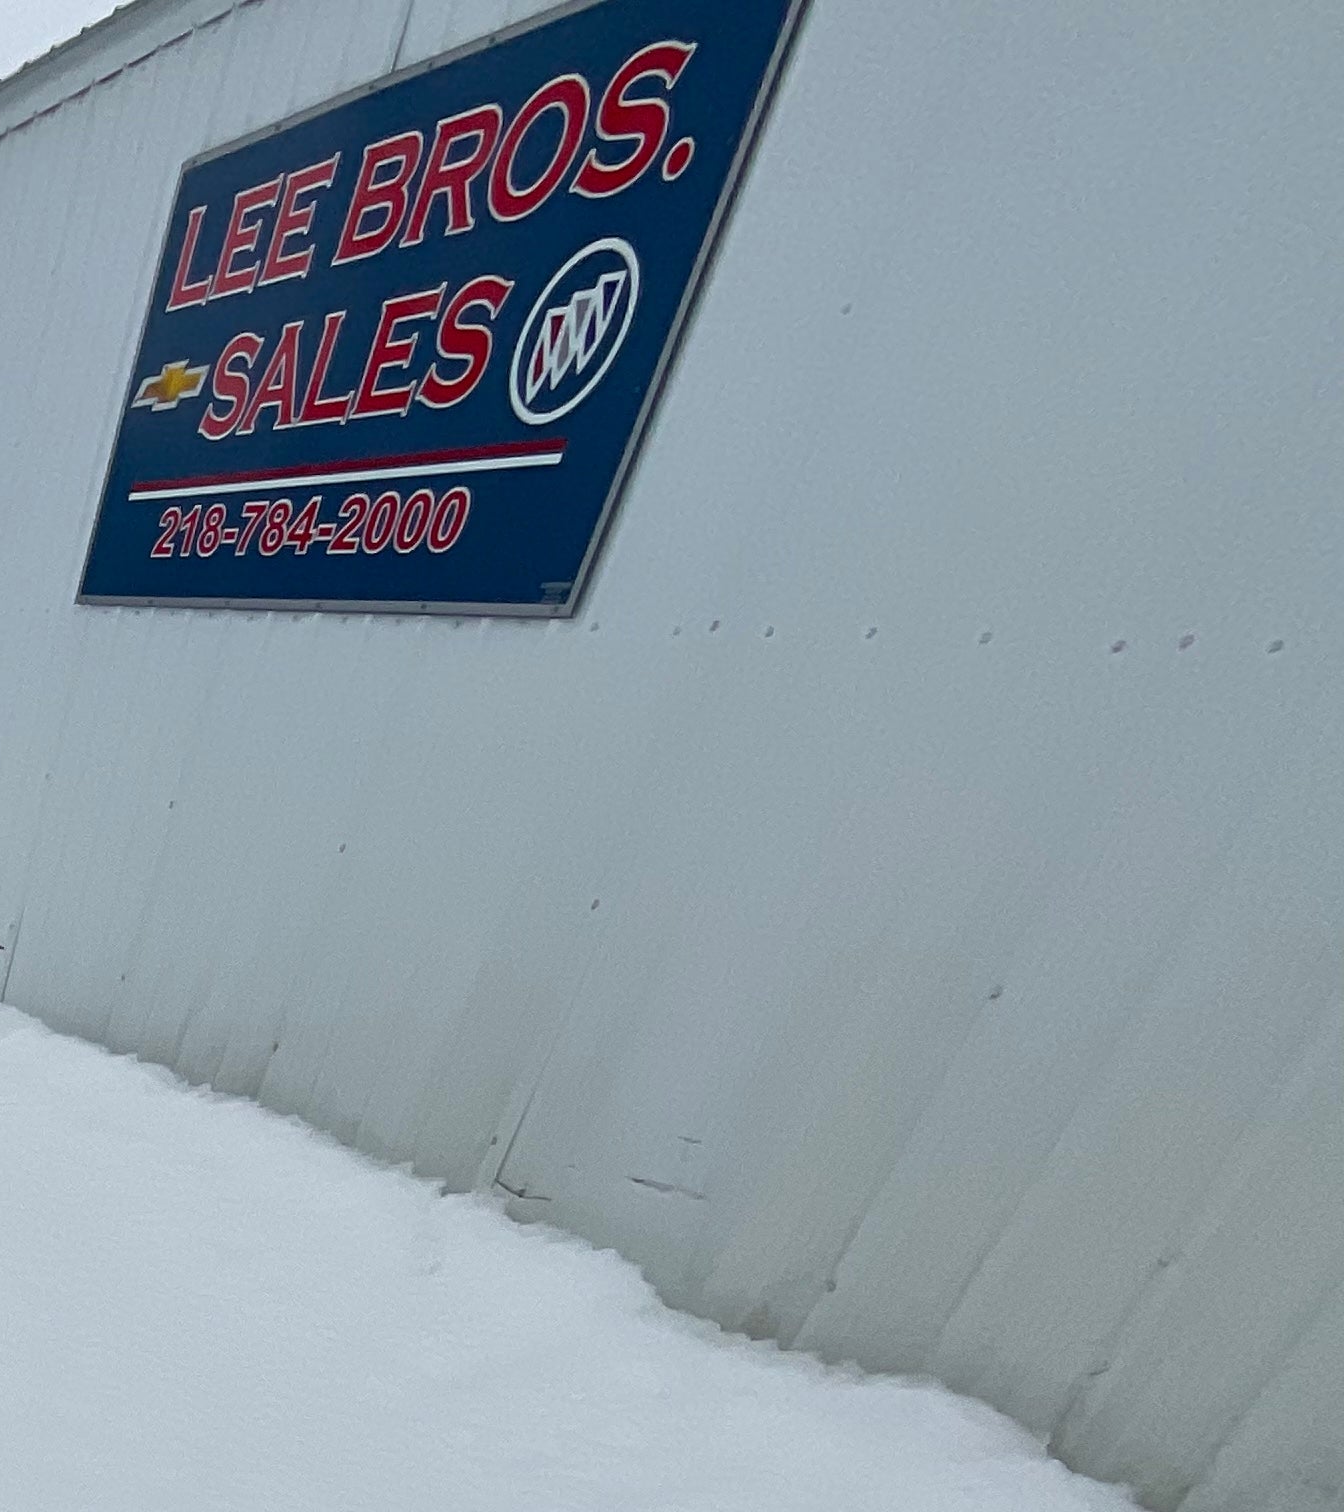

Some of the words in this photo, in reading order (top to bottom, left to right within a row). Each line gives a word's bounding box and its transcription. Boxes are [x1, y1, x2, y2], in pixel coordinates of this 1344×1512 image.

[165, 151, 341, 312] LEE
[332, 40, 697, 267] BROS.
[198, 274, 516, 442] SALES
[150, 485, 471, 560] 218-784-2000
